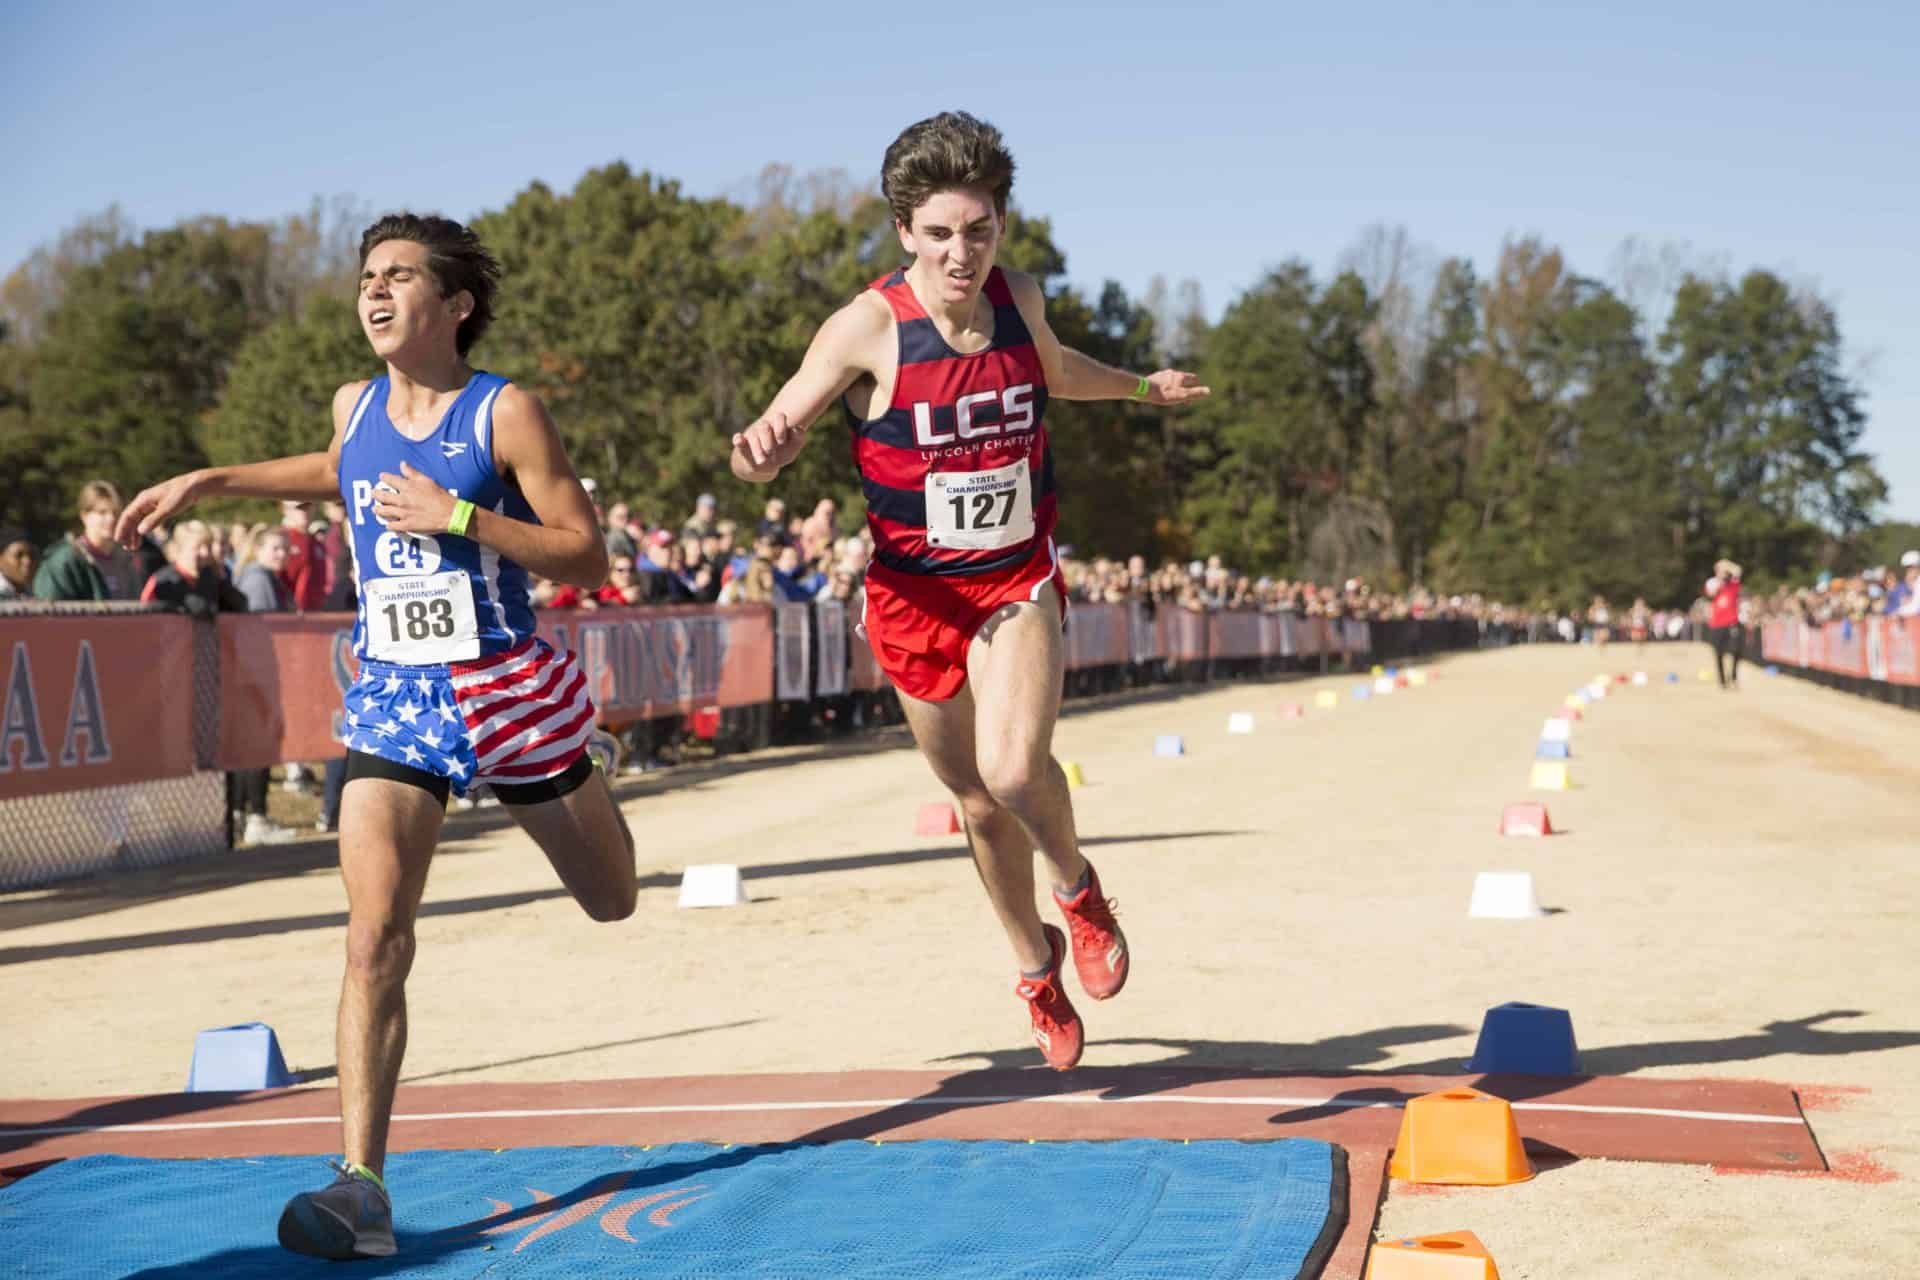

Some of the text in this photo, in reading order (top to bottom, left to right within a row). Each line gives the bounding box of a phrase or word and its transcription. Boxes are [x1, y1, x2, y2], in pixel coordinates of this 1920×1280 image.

[913, 383, 1034, 446] LCS
[921, 443, 980, 461] LINCOLN
[946, 479, 1017, 494] CHAMPIONSHIP
[968, 475, 997, 485] STATE
[948, 488, 1017, 530] 127
[389, 537, 424, 569] 24
[398, 580, 426, 591] STATE
[378, 588, 450, 602] CHAMPIONSHIP
[382, 598, 455, 642] 183
